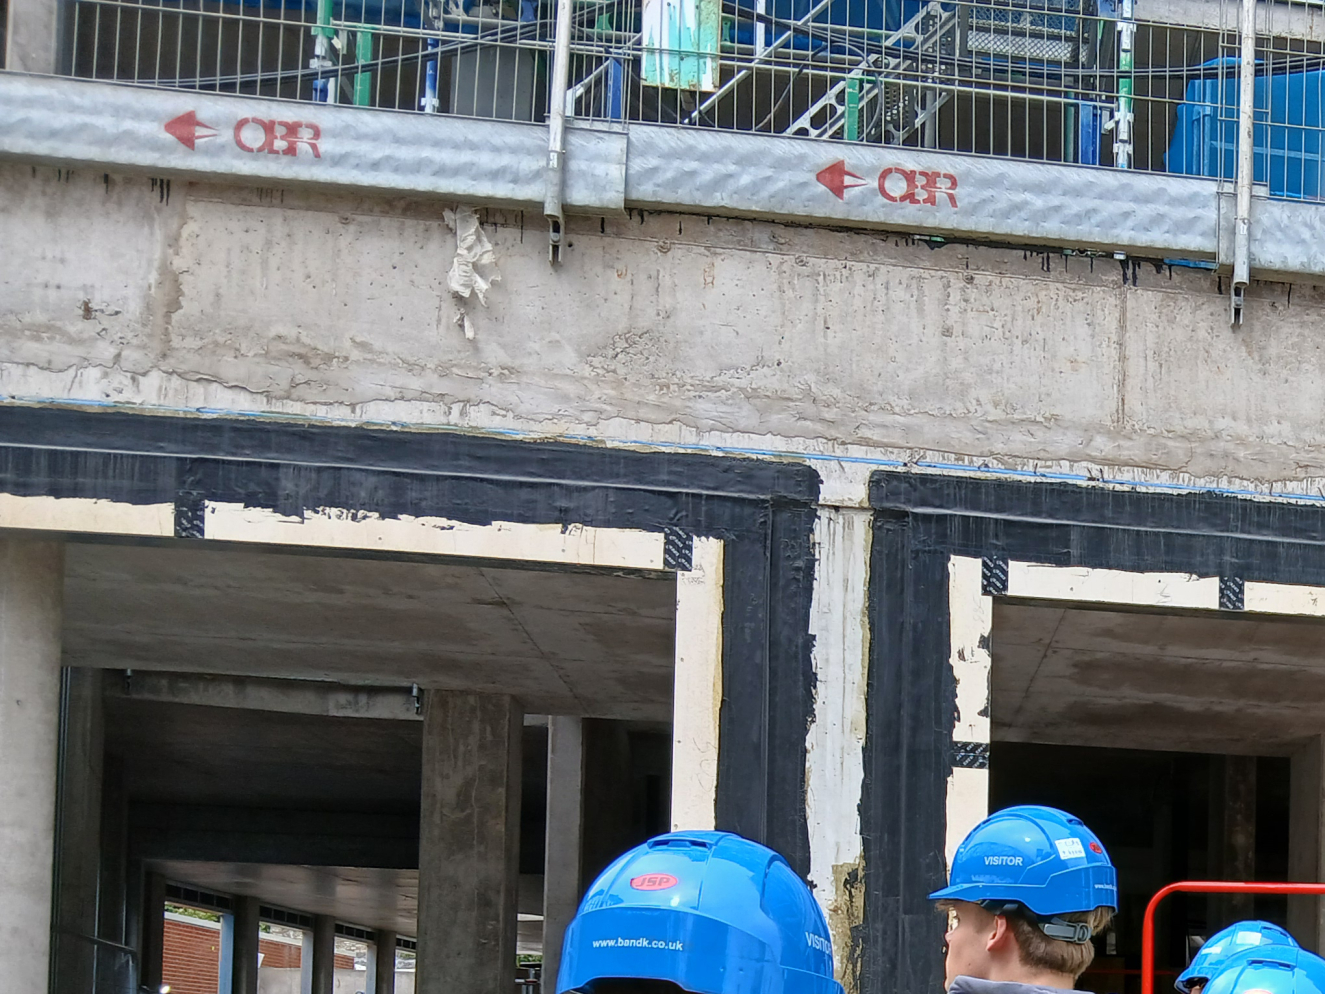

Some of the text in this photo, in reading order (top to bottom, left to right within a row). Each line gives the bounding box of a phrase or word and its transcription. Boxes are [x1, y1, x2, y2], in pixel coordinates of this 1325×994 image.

[984, 856, 1023, 866] VISITOR
[635, 876, 671, 887] JSP
[592, 937, 683, 951] www.bandk.co.uk
